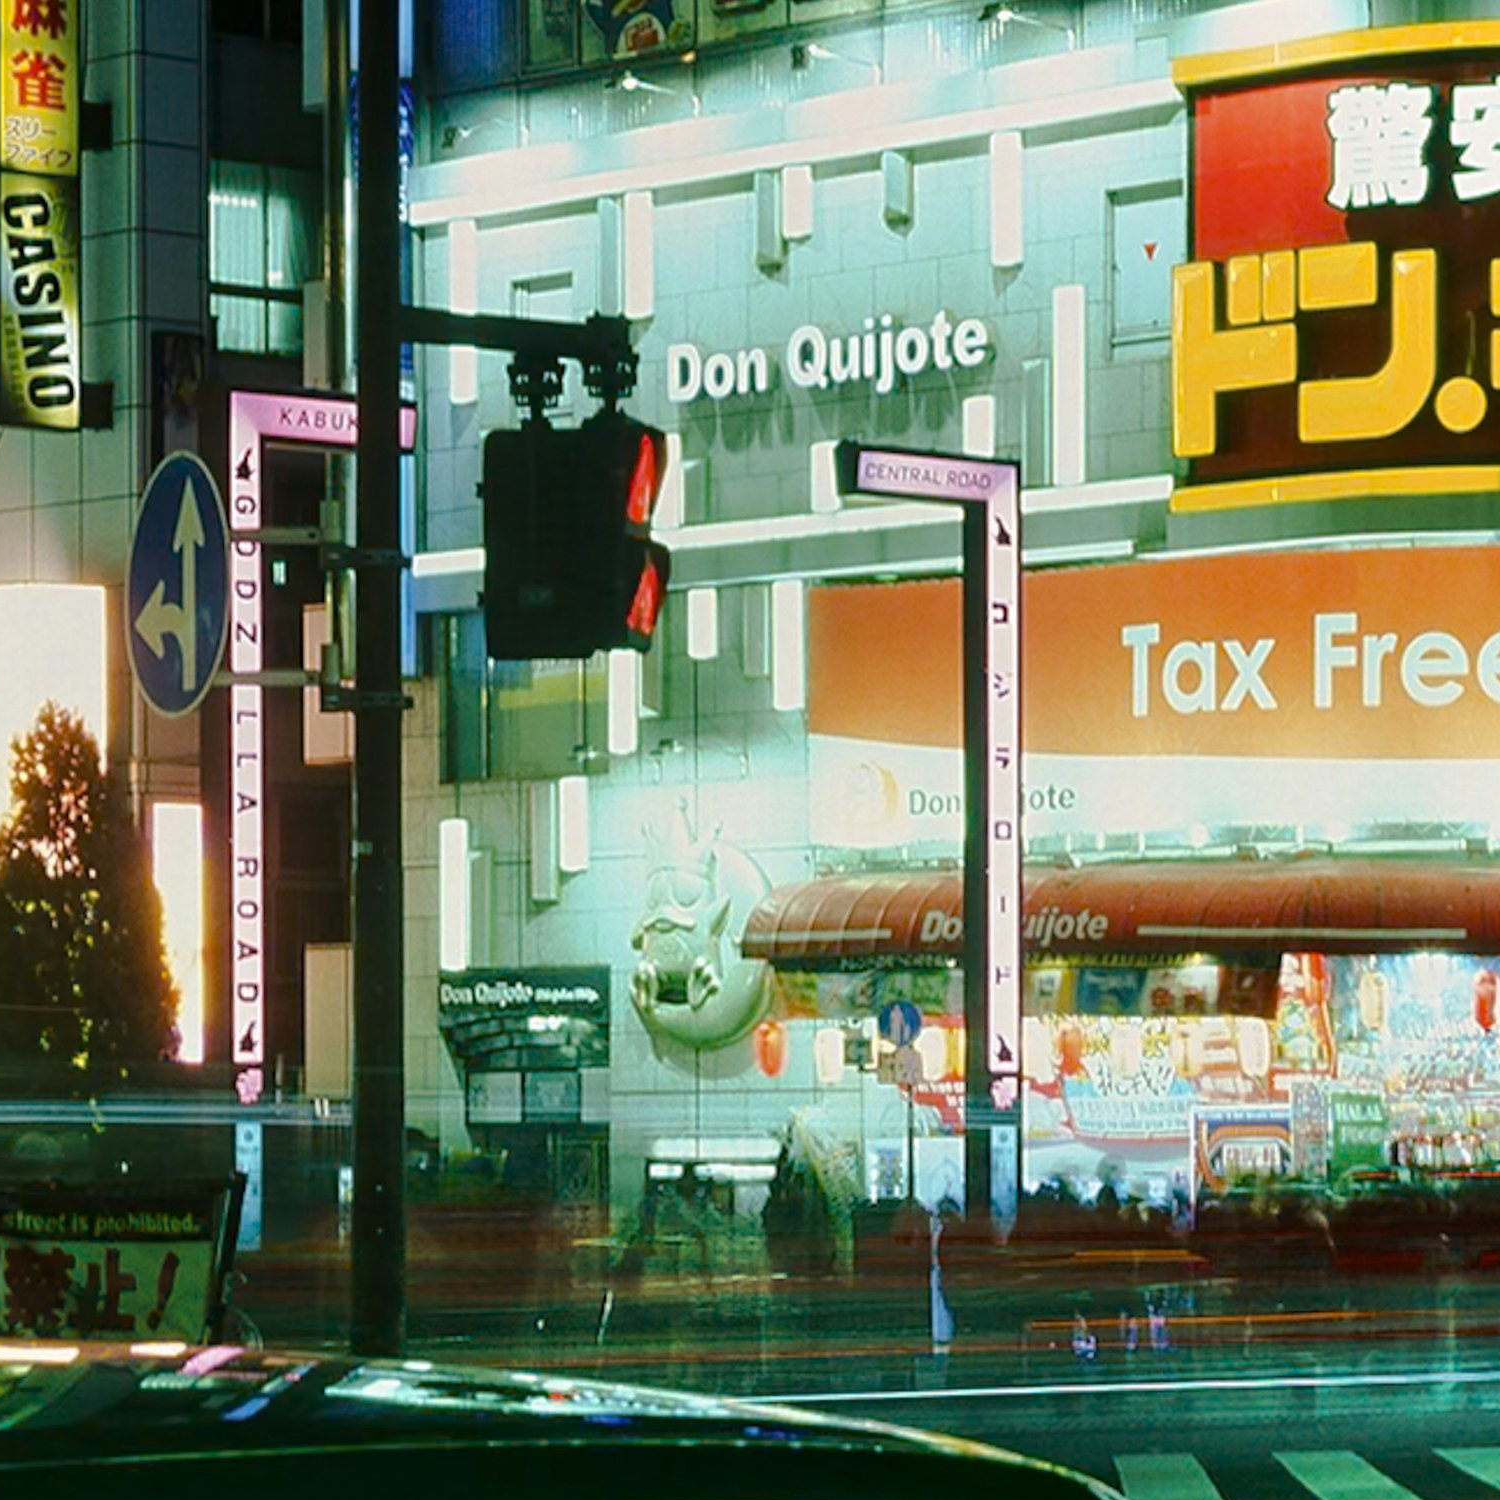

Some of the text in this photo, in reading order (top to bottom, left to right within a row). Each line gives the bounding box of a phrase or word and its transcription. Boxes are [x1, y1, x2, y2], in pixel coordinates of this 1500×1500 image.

[2, 192, 77, 411] CASINO
[667, 309, 989, 401] Don Quijote
[863, 461, 992, 492] CENTRAL ROAD
[1121, 623, 1278, 716] Tax
[233, 495, 258, 1003] GODZLLA ROAD
[908, 784, 1076, 816] Don jote
[921, 908, 1108, 945] Do uijote
